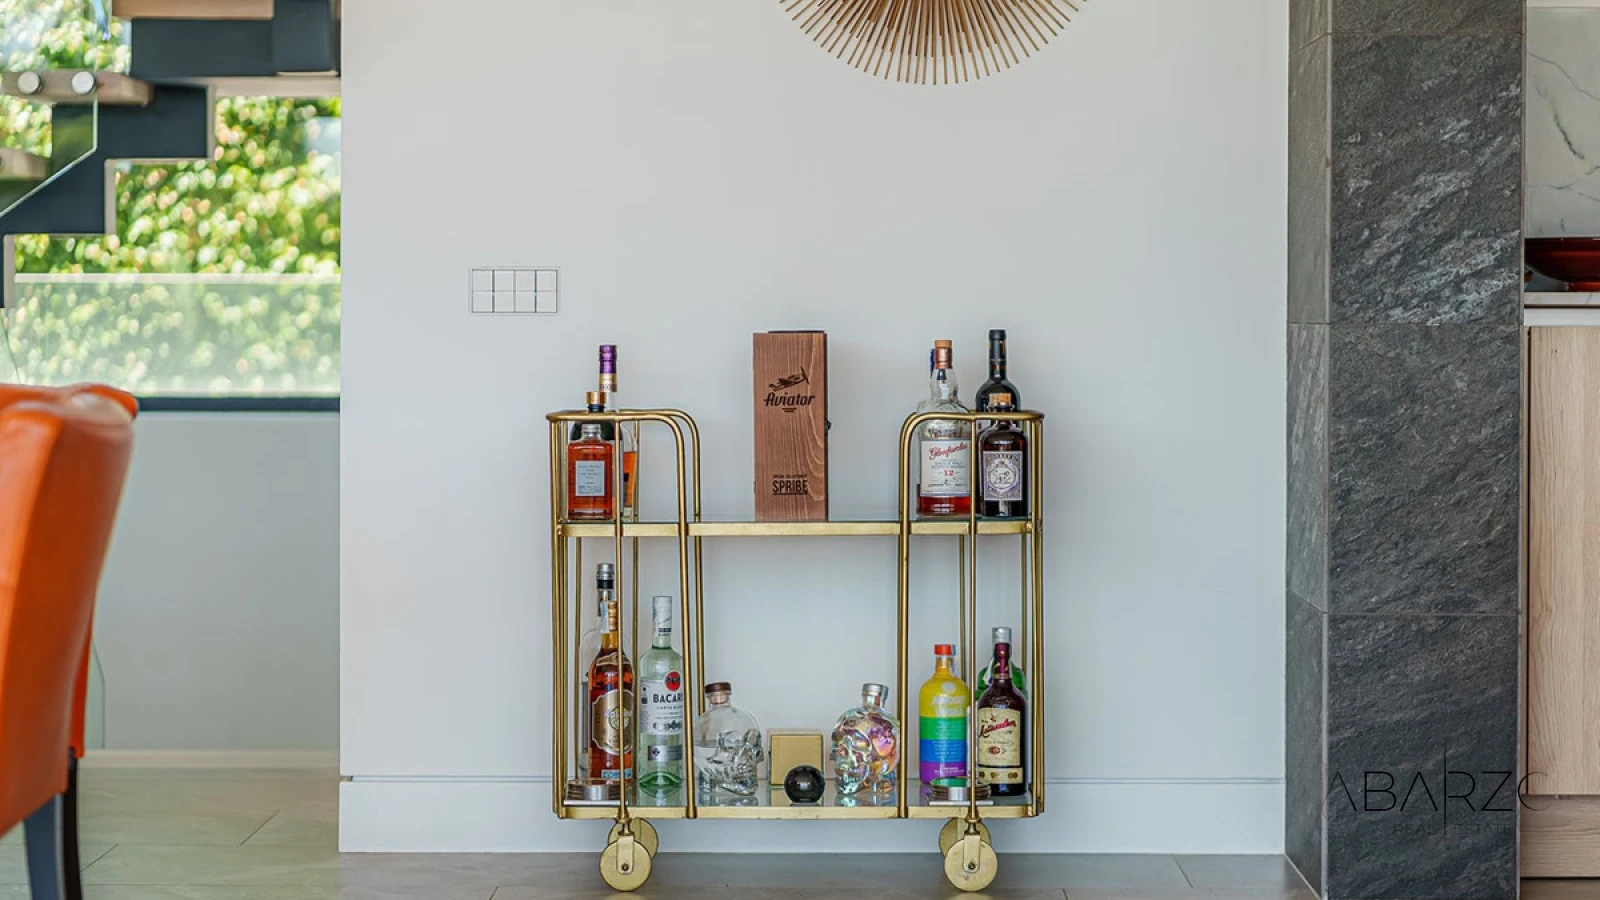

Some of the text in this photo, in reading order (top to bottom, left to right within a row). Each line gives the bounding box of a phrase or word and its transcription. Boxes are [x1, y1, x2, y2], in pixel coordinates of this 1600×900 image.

[764, 392, 815, 406] Aviator
[943, 469, 954, 477] 12
[772, 480, 809, 493] SPRIBE
